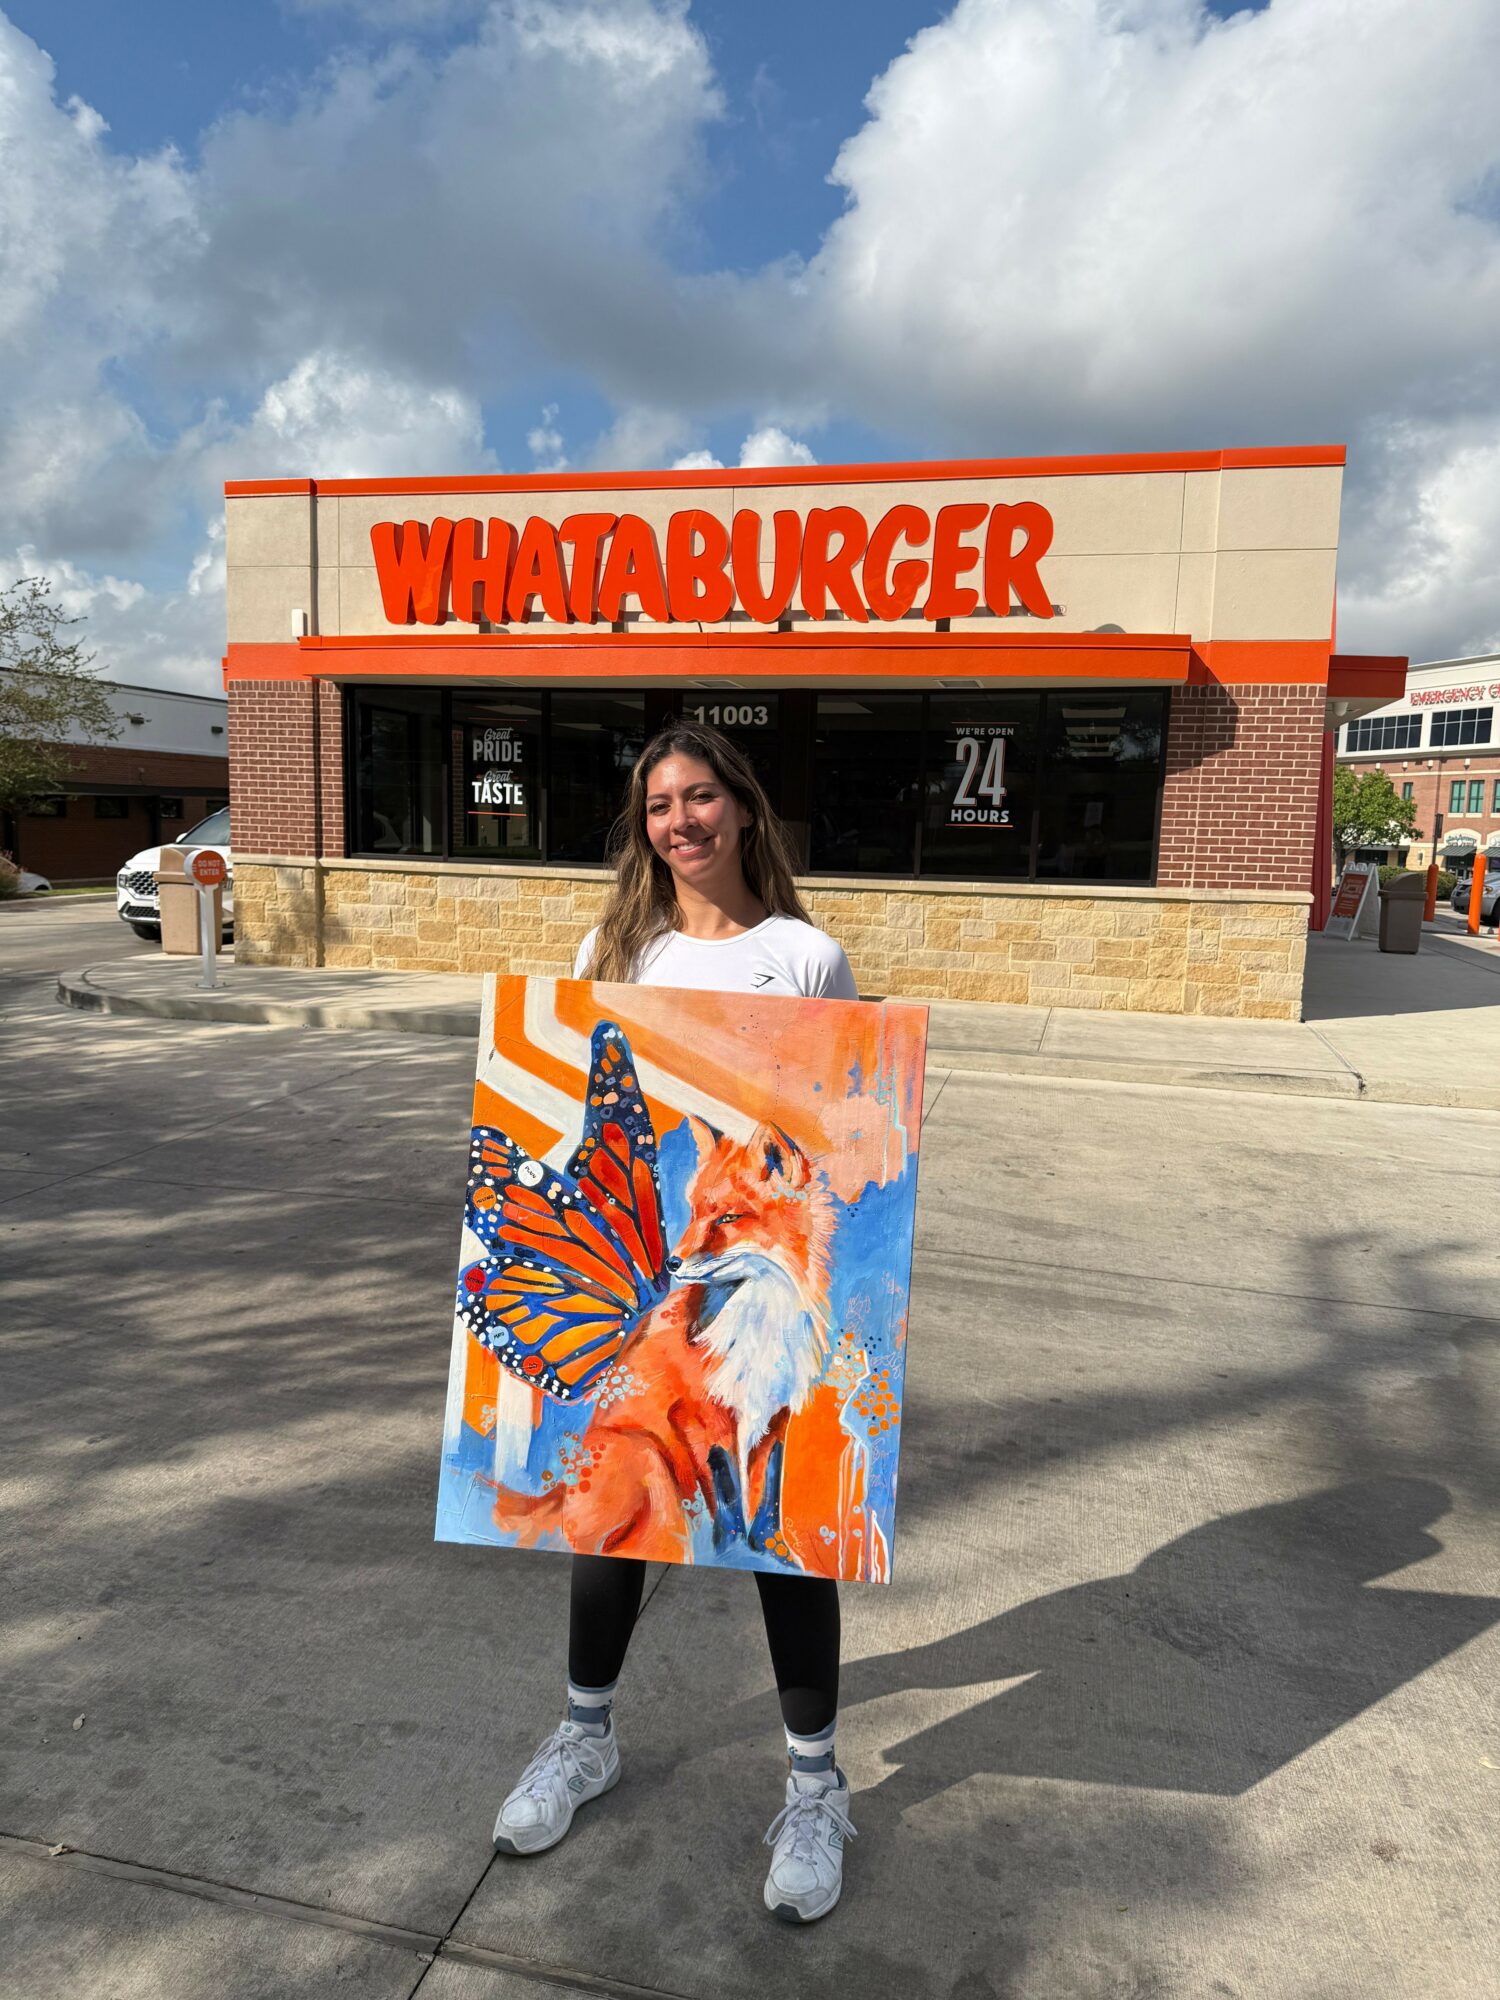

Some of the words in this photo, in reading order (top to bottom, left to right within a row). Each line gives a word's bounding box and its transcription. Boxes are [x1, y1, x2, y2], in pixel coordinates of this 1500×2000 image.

[370, 502, 1055, 625] WHATABURGER
[1410, 686, 1486, 706] EMERGENCY
[694, 706, 768, 725] 11003
[484, 727, 514, 741] Great
[956, 727, 985, 735] WE'RE
[988, 727, 1014, 736] OPEN
[472, 739, 523, 763] PRIDE
[484, 769, 514, 783] Great
[953, 736, 1007, 807] 24
[471, 781, 524, 805] TASTE
[951, 809, 1009, 823] HOURS
[197, 859, 208, 868] DO
[208, 859, 221, 868] NOT
[200, 868, 220, 876] ENTER
